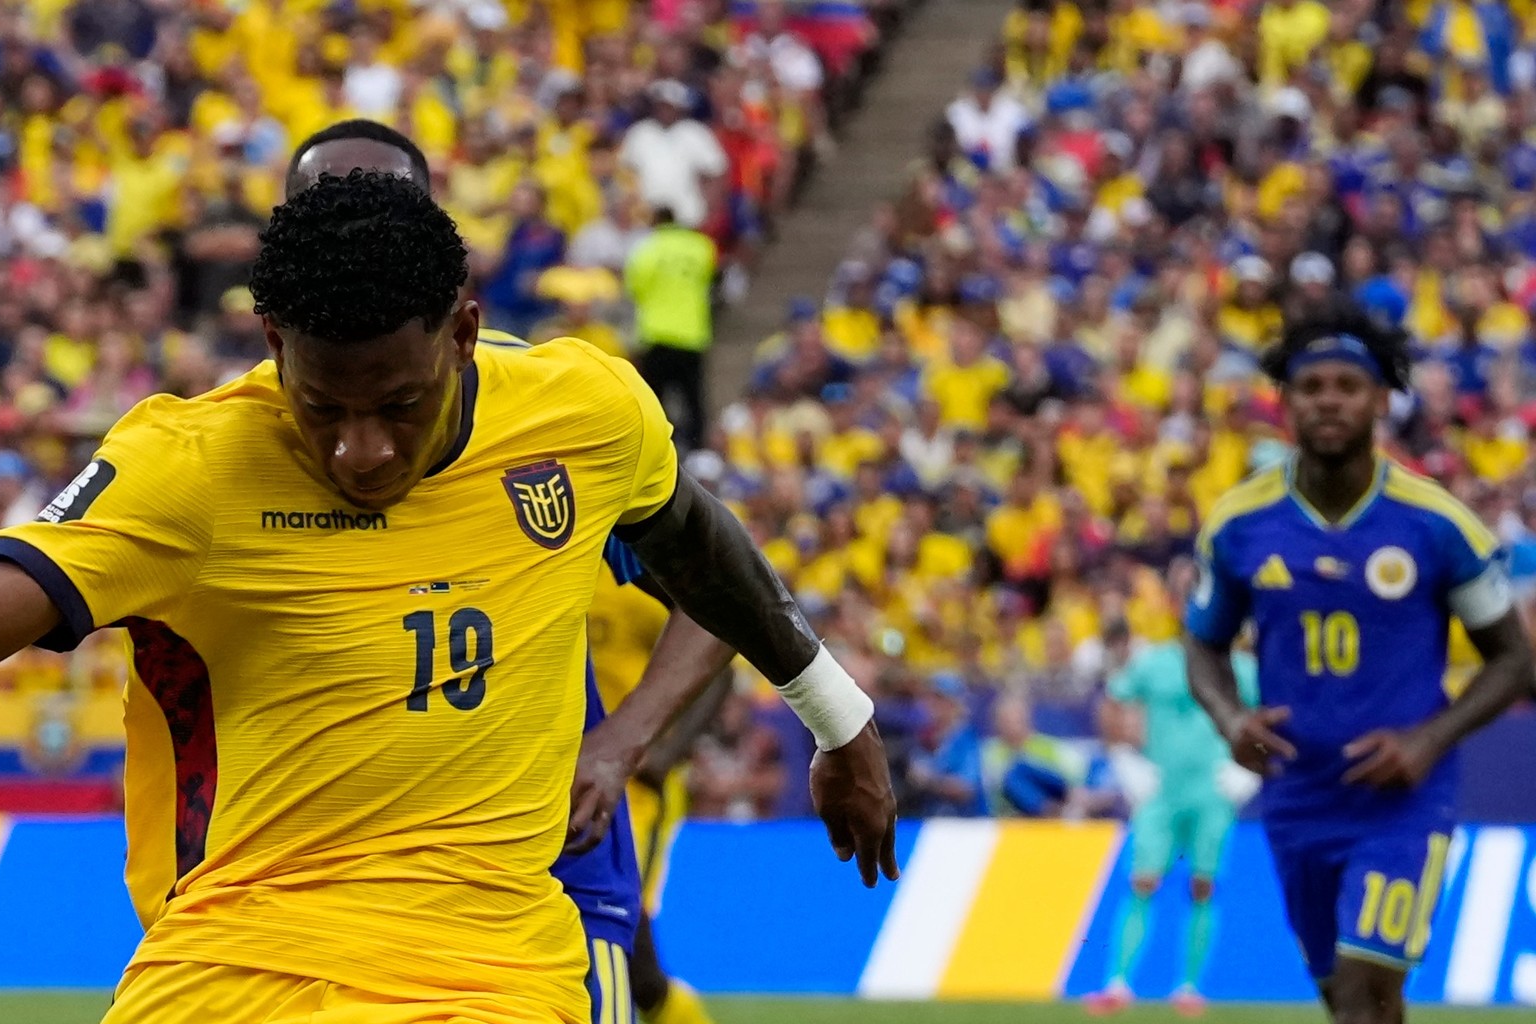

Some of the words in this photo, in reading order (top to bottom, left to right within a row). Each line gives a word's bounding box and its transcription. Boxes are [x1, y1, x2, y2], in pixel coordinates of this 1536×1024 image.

[261, 509, 387, 530] marathon
[402, 606, 494, 712] 19
[1300, 609, 1361, 677] 10
[1357, 871, 1415, 945] 10
